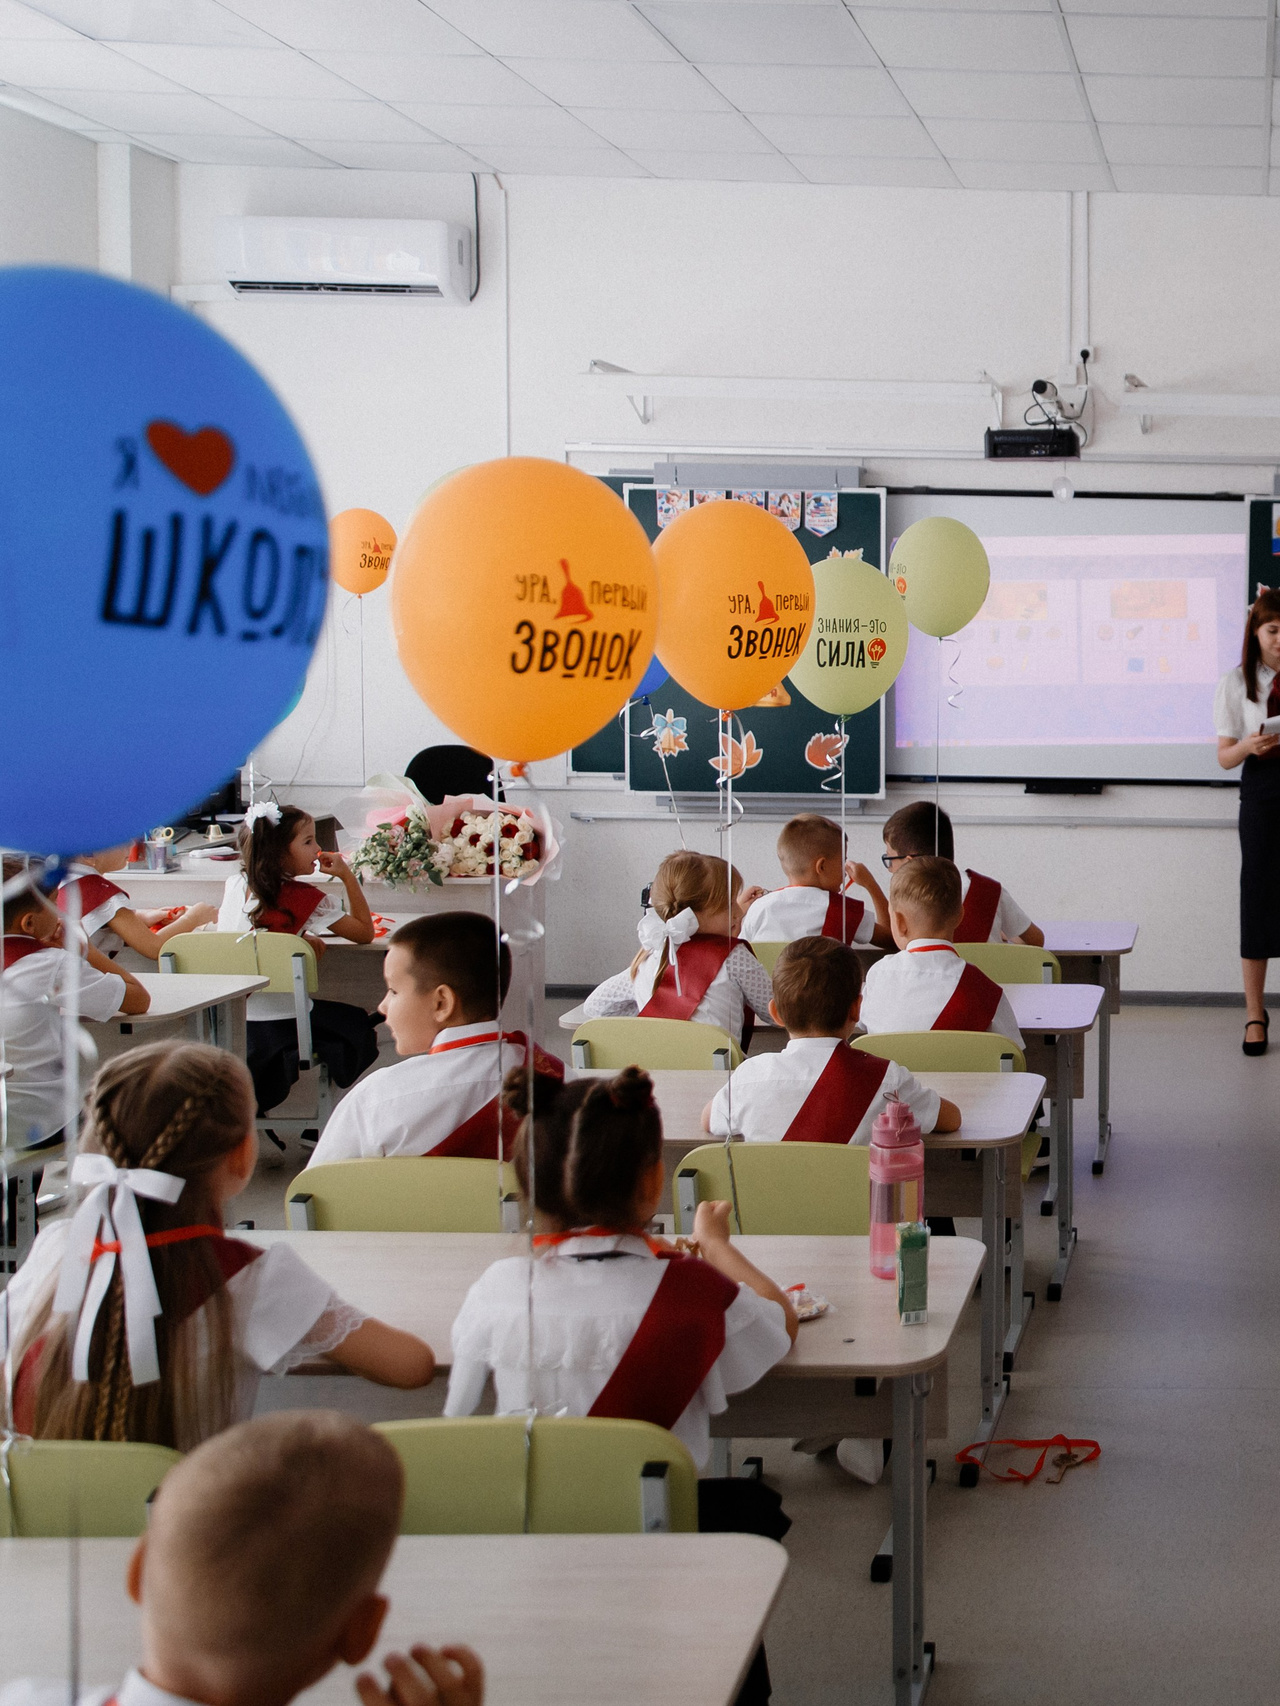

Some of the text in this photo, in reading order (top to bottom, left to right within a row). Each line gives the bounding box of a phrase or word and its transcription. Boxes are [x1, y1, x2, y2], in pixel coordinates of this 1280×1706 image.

[511, 619, 643, 681] ЗВОНОК
[727, 623, 806, 660] ЗВОНОК
[816, 637, 866, 669] СИЛА
